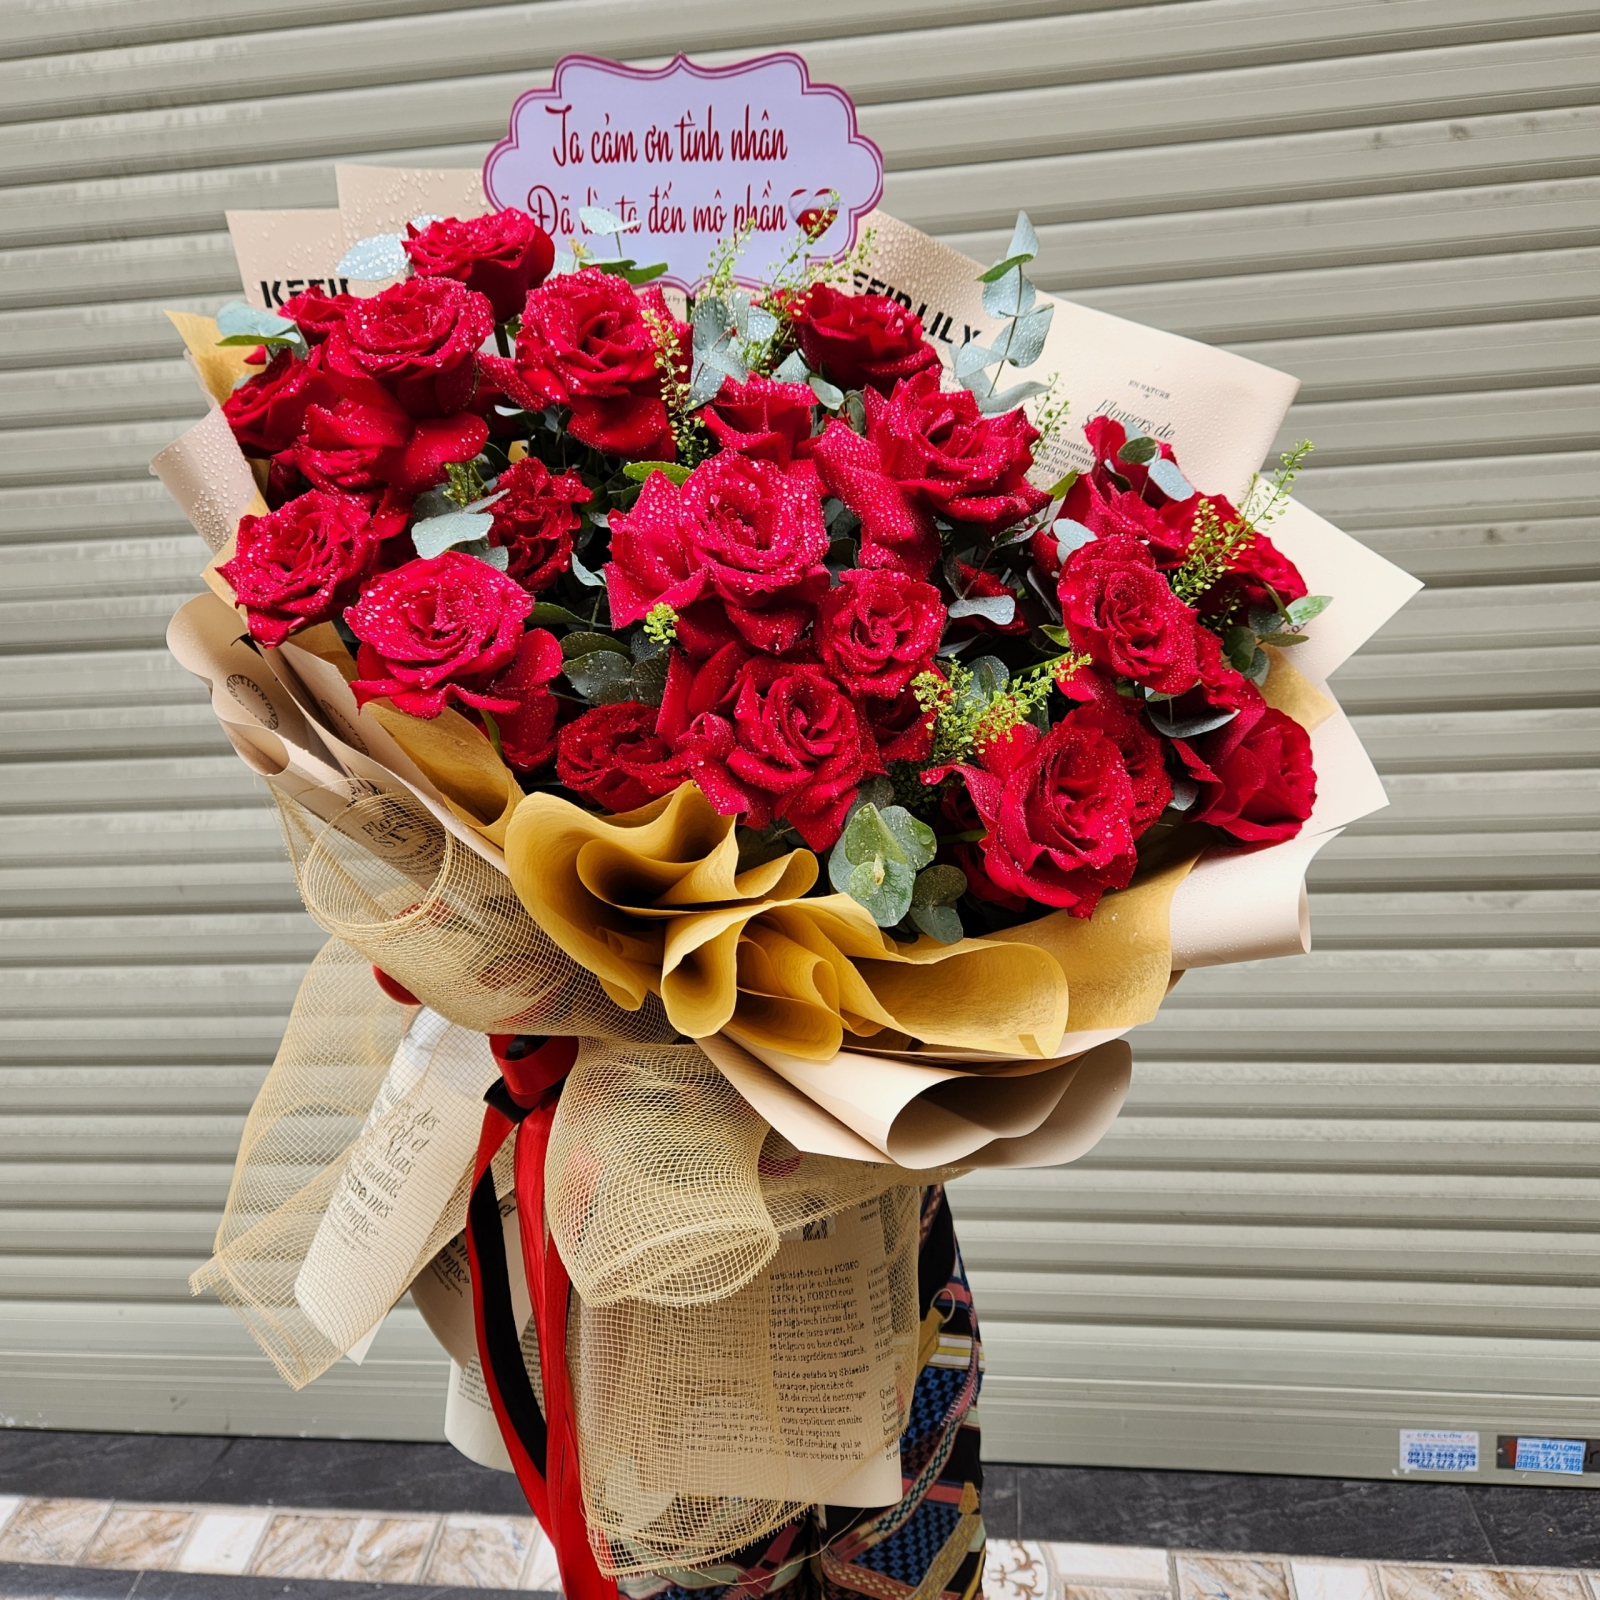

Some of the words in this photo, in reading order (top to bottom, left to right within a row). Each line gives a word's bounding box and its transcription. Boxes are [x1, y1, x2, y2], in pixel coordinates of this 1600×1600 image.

[545, 104, 584, 167] Ta
[591, 112, 638, 164] cảm
[645, 124, 674, 163] ơn
[674, 104, 724, 162] tình
[731, 103, 788, 162] nhân
[527, 185, 575, 236] Đã
[648, 181, 687, 234] đến
[693, 189, 728, 246] mộ
[734, 179, 788, 250] phần
[1154, 421, 1176, 440] de
[1046, 443, 1071, 460] erpo)
[1061, 439, 1089, 454] nunca
[807, 1289, 838, 1301] FOREO
